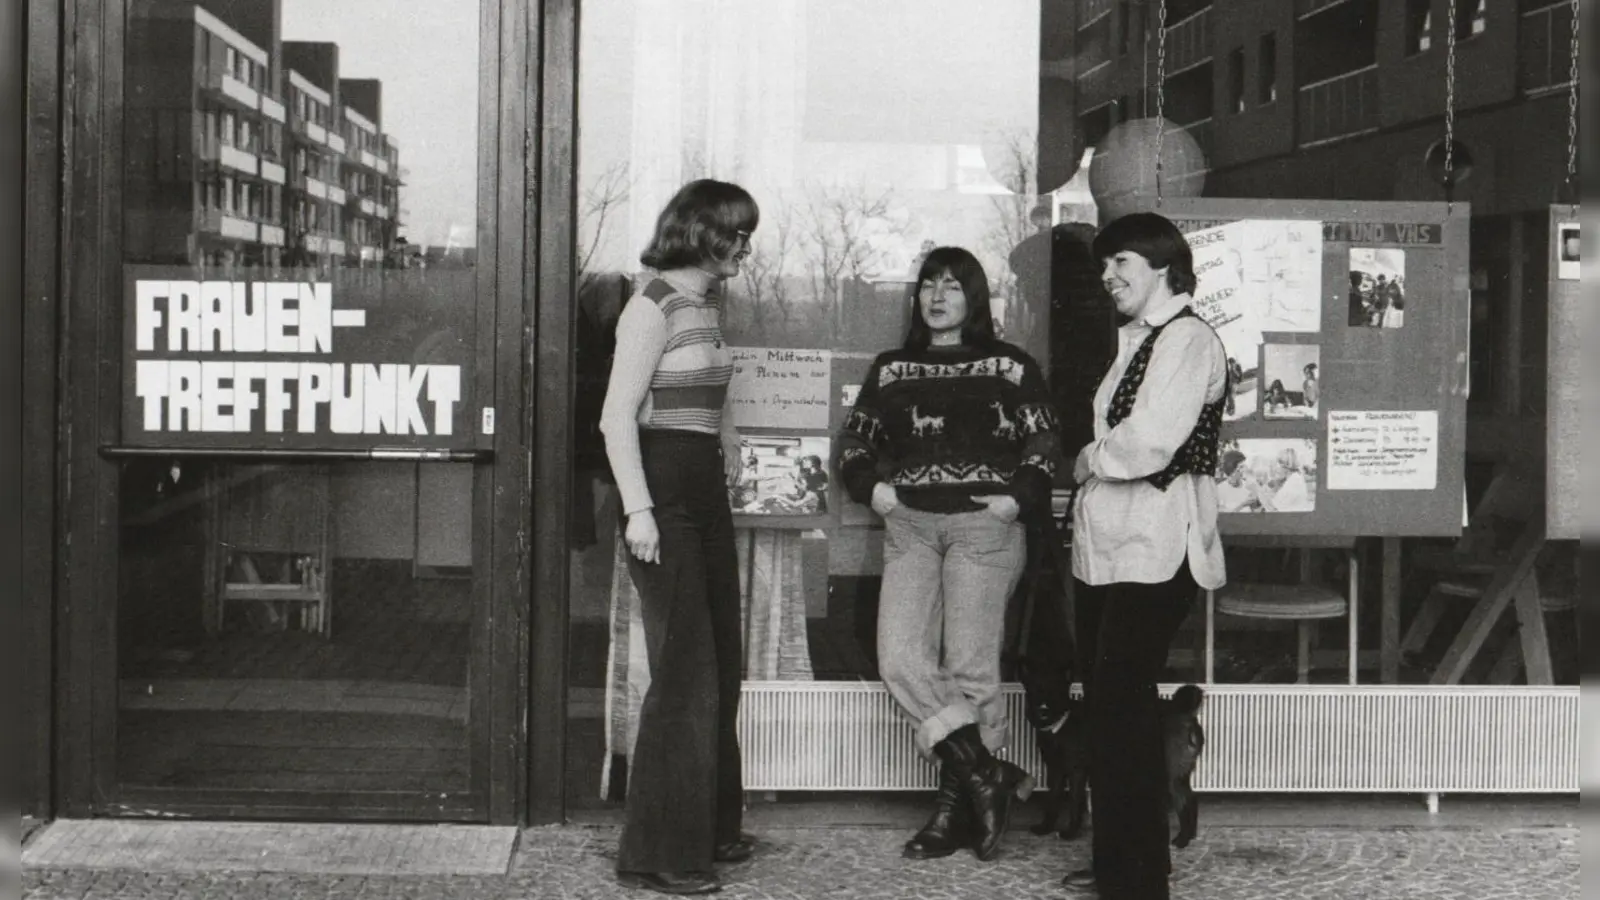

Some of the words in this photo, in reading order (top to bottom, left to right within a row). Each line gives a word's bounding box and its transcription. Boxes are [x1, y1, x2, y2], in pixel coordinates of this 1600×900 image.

[1351, 222, 1385, 242] UND
[1395, 223, 1431, 243] VHS
[136, 280, 365, 353] FRAUEN-
[767, 350, 824, 363] Mittwoch
[136, 360, 460, 435] TREFFPUNKT
